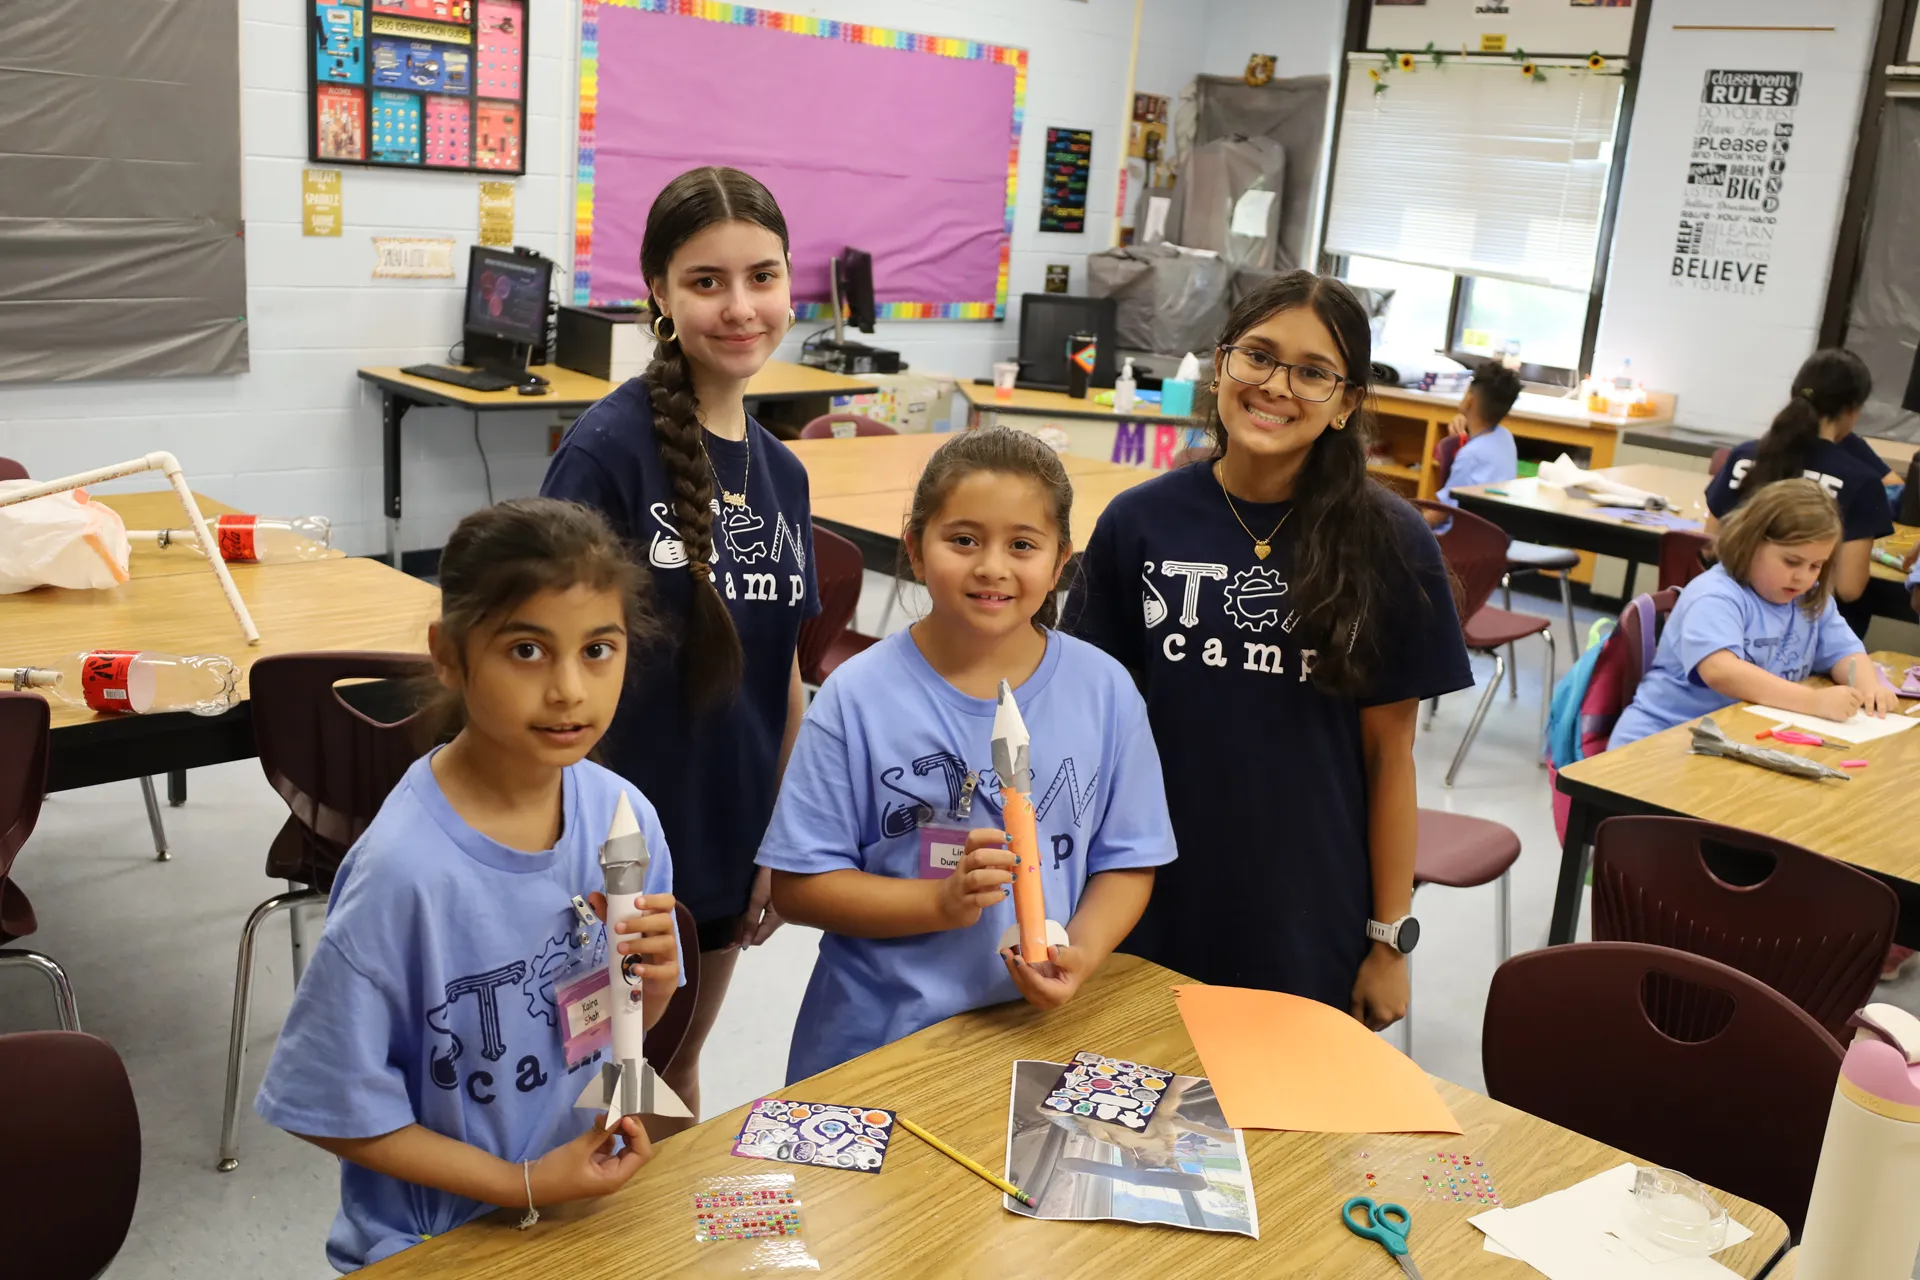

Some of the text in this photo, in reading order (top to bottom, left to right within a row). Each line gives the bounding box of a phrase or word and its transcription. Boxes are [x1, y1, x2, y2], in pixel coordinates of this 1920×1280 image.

[373, 18, 469, 40] DRUG IDENTIFICATION GUIDE
[1711, 70, 1794, 88] classroom
[328, 86, 352, 96] ALCOHOL
[1711, 85, 1790, 105] RULES
[1699, 105, 1796, 121] DO YOUR BEST
[1730, 164, 1765, 176] DREAM
[1684, 185, 1722, 198] LISTEN
[1726, 176, 1762, 200] BIG
[1675, 220, 1693, 254] HELP
[1720, 222, 1774, 239] LEARN
[1671, 256, 1768, 285] BELIEVE
[1692, 280, 1765, 296] YOURSELF
[648, 498, 806, 572] SeM
[709, 571, 805, 607] amp
[1142, 560, 1330, 640] STe
[880, 751, 1099, 839] STM
[582, 999, 599, 1013] Kaira
[584, 1010, 600, 1026] Shah
[466, 1050, 602, 1105] ca
